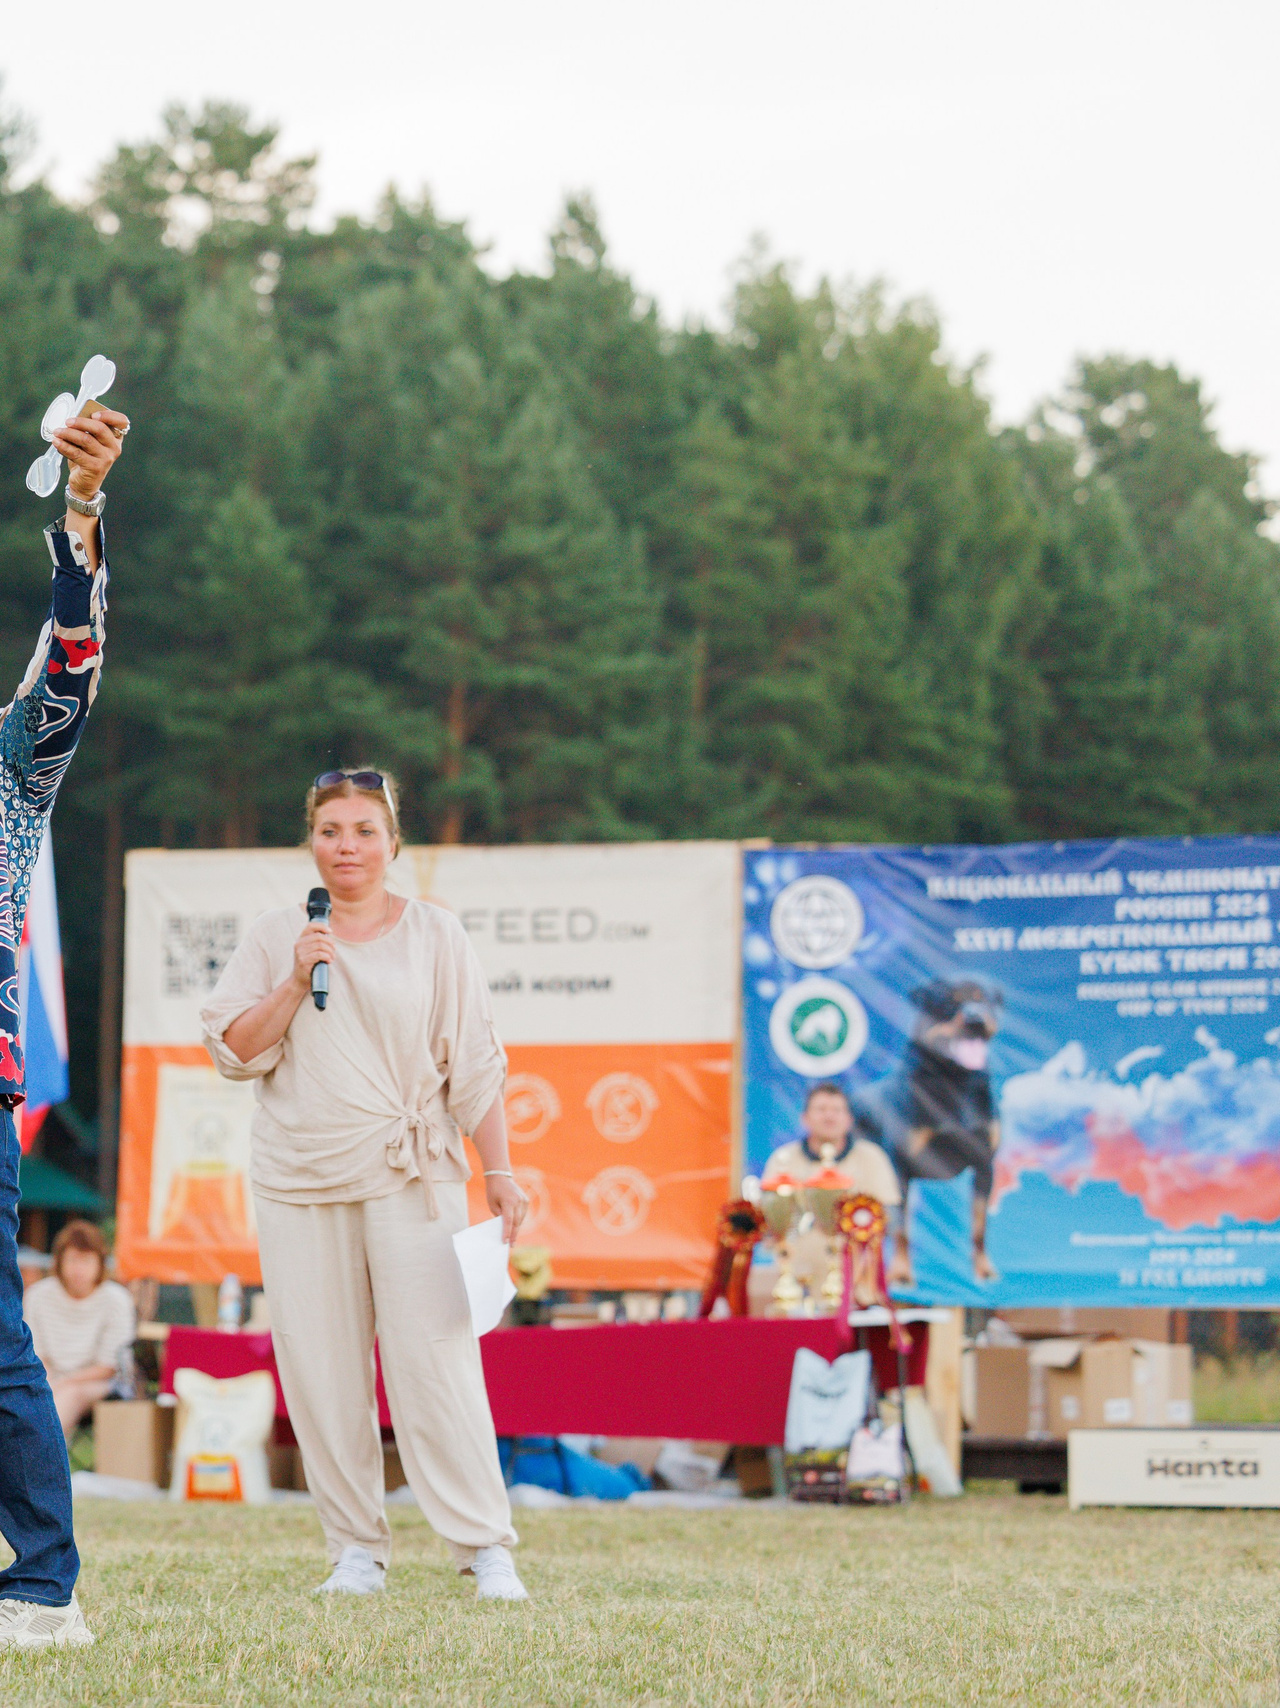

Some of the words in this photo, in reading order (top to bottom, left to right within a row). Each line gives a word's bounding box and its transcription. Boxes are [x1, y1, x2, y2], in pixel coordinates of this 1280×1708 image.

[1115, 895, 1211, 921] РОССИИ
[1215, 893, 1269, 919] 2024
[1146, 1458, 1260, 1478] Hanta
